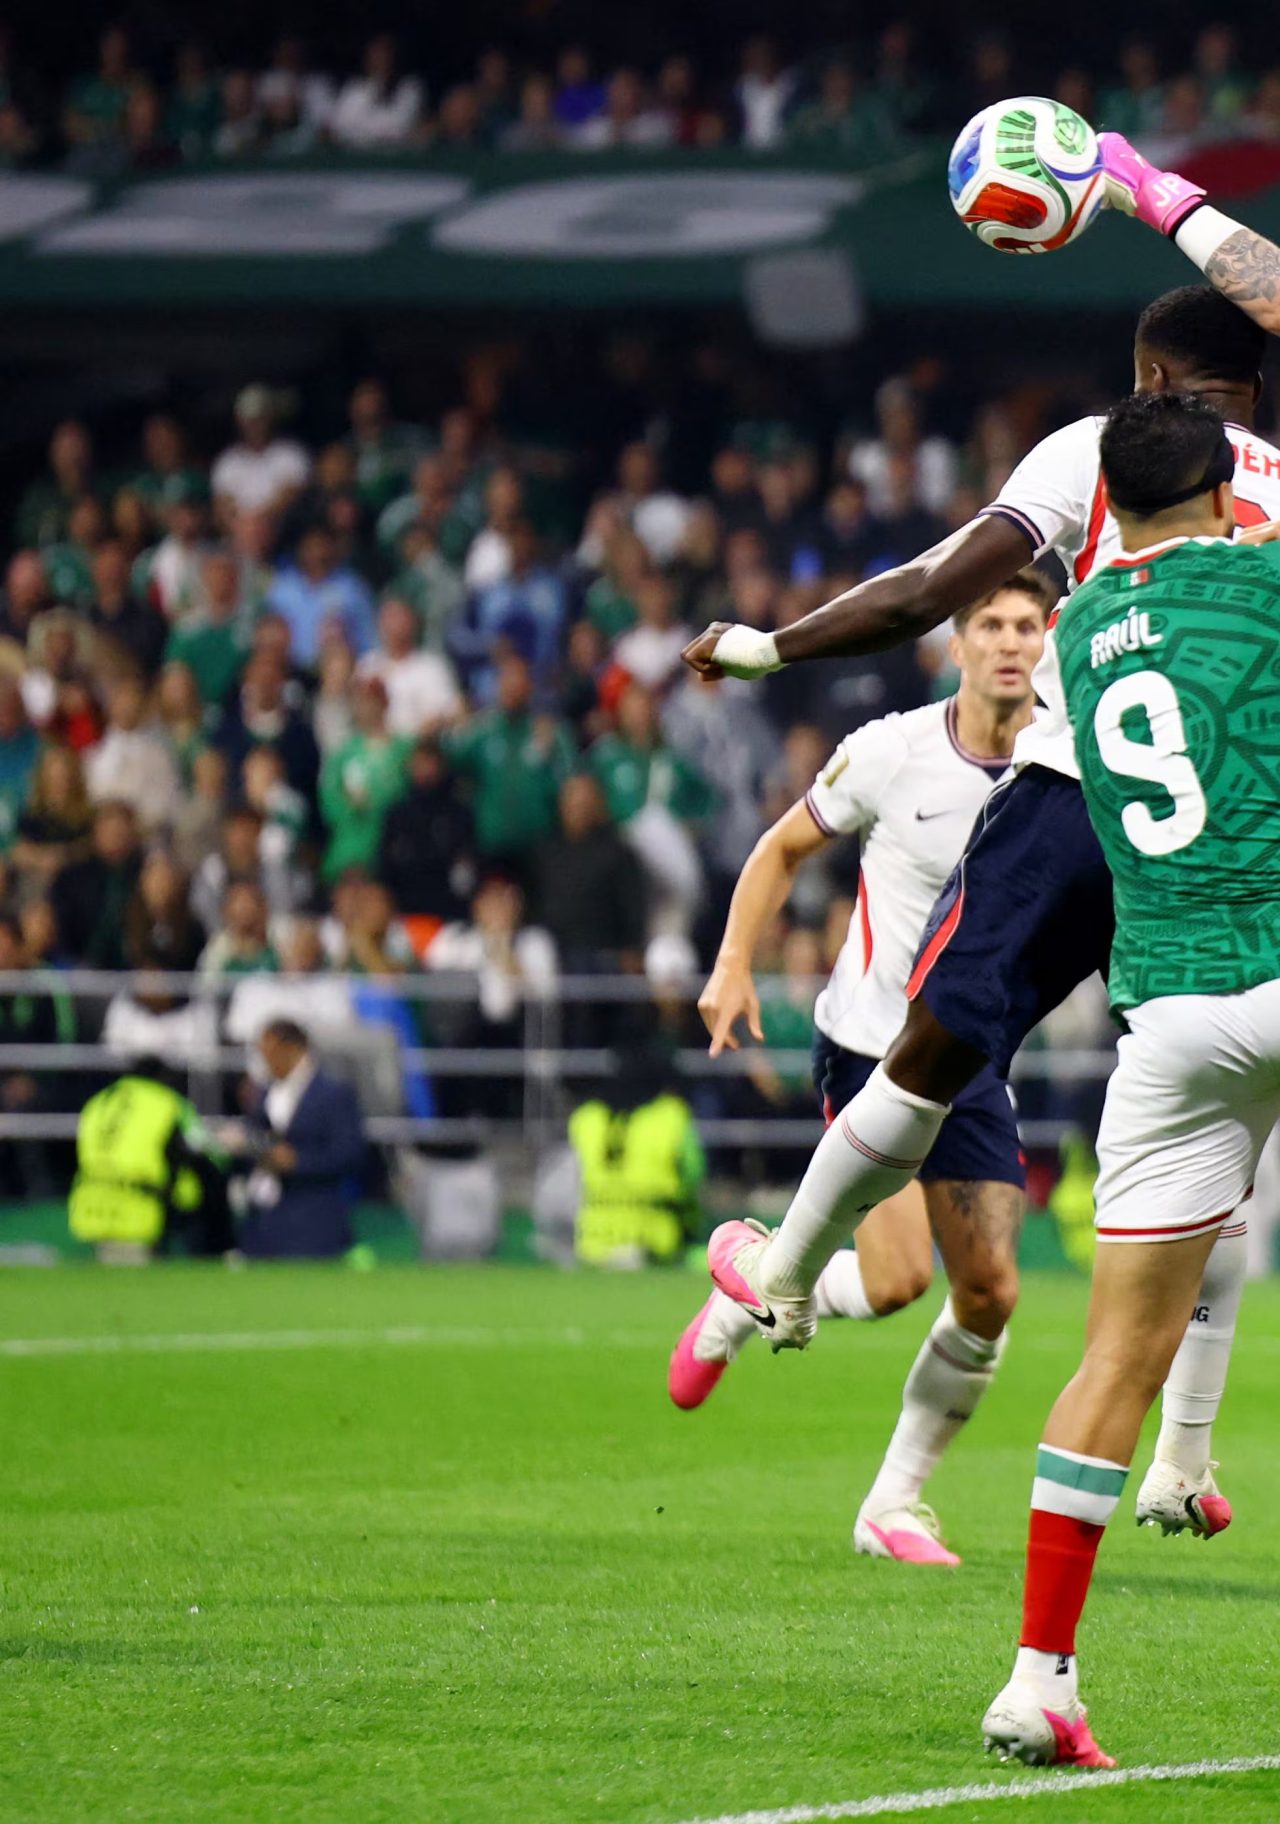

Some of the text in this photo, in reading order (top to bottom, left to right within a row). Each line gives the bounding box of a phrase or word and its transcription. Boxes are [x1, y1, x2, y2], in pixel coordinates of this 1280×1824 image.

[1151, 173, 1184, 208] JP
[1090, 606, 1163, 669] RAÚL
[1094, 670, 1207, 856] 9
